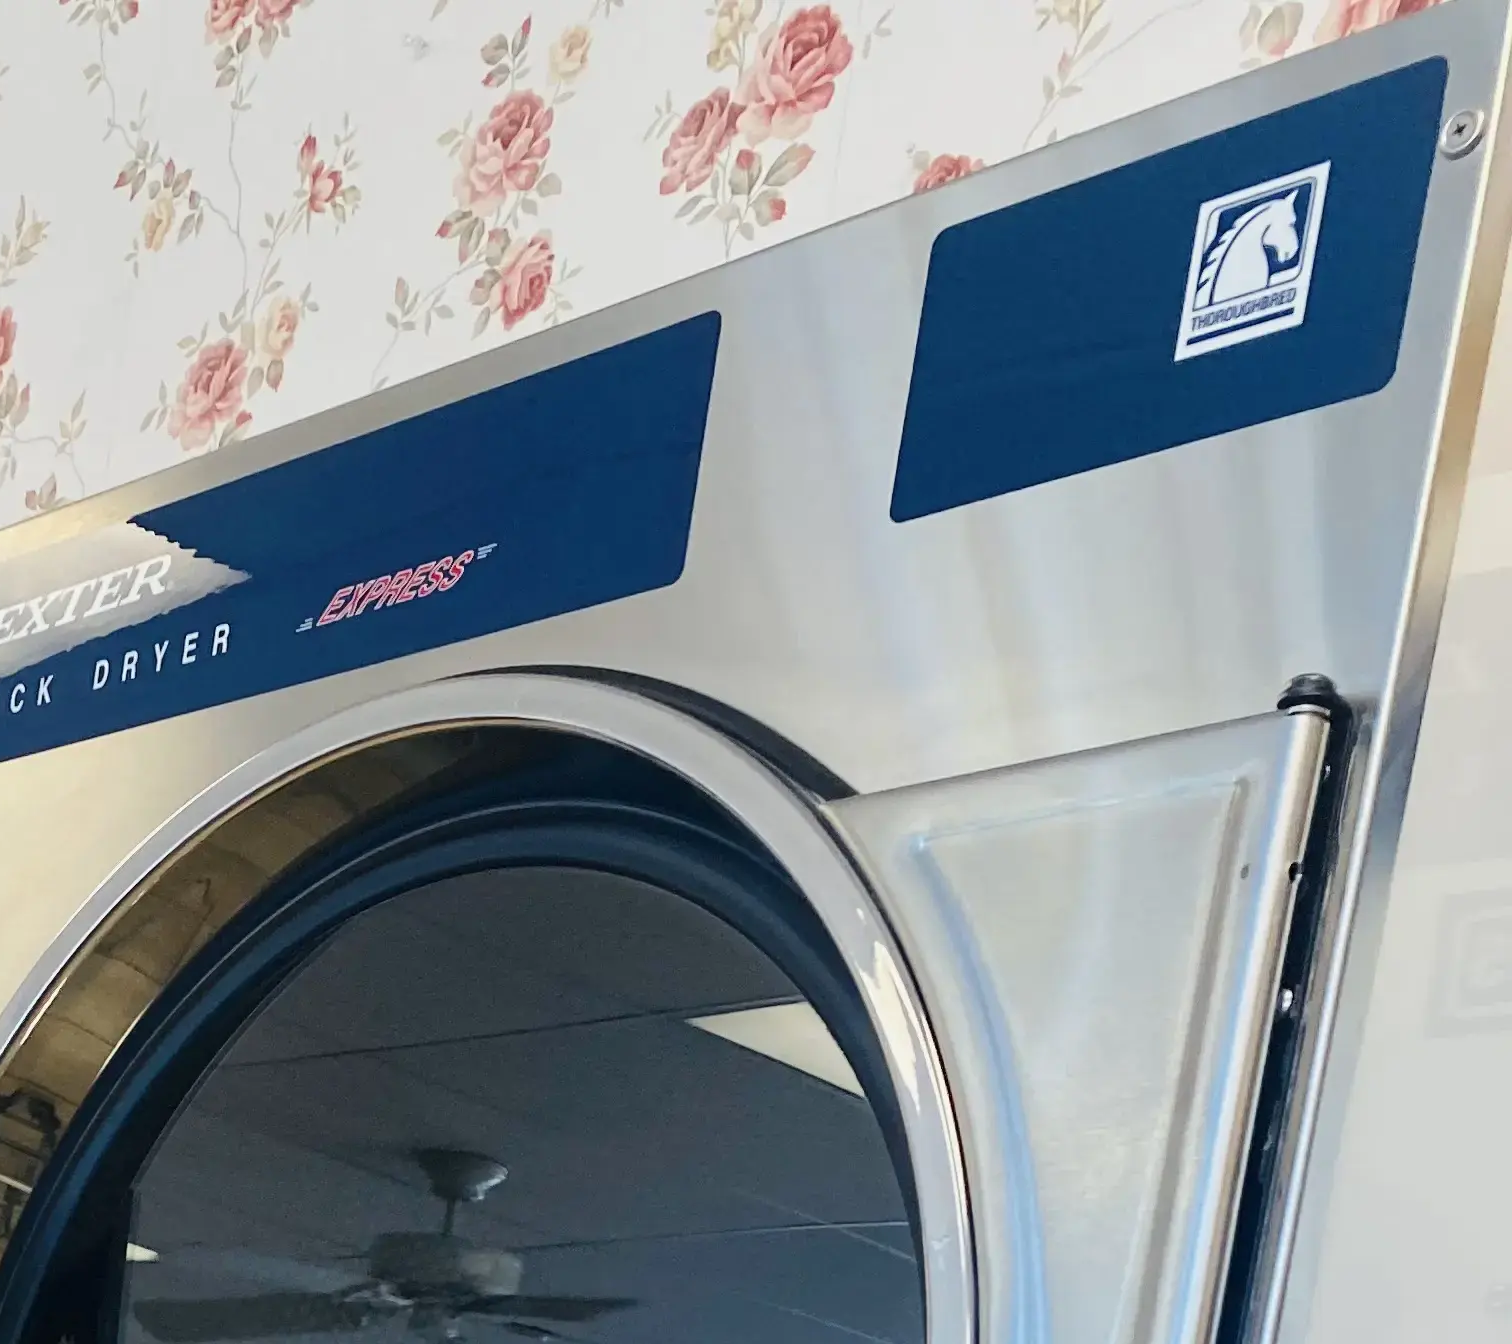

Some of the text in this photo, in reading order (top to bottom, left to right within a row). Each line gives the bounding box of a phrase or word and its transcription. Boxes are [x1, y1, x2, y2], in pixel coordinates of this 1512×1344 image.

[1191, 287, 1297, 331] THOROUGHBRED
[316, 550, 474, 627] EXPRESS
[92, 622, 230, 691] DRYER
